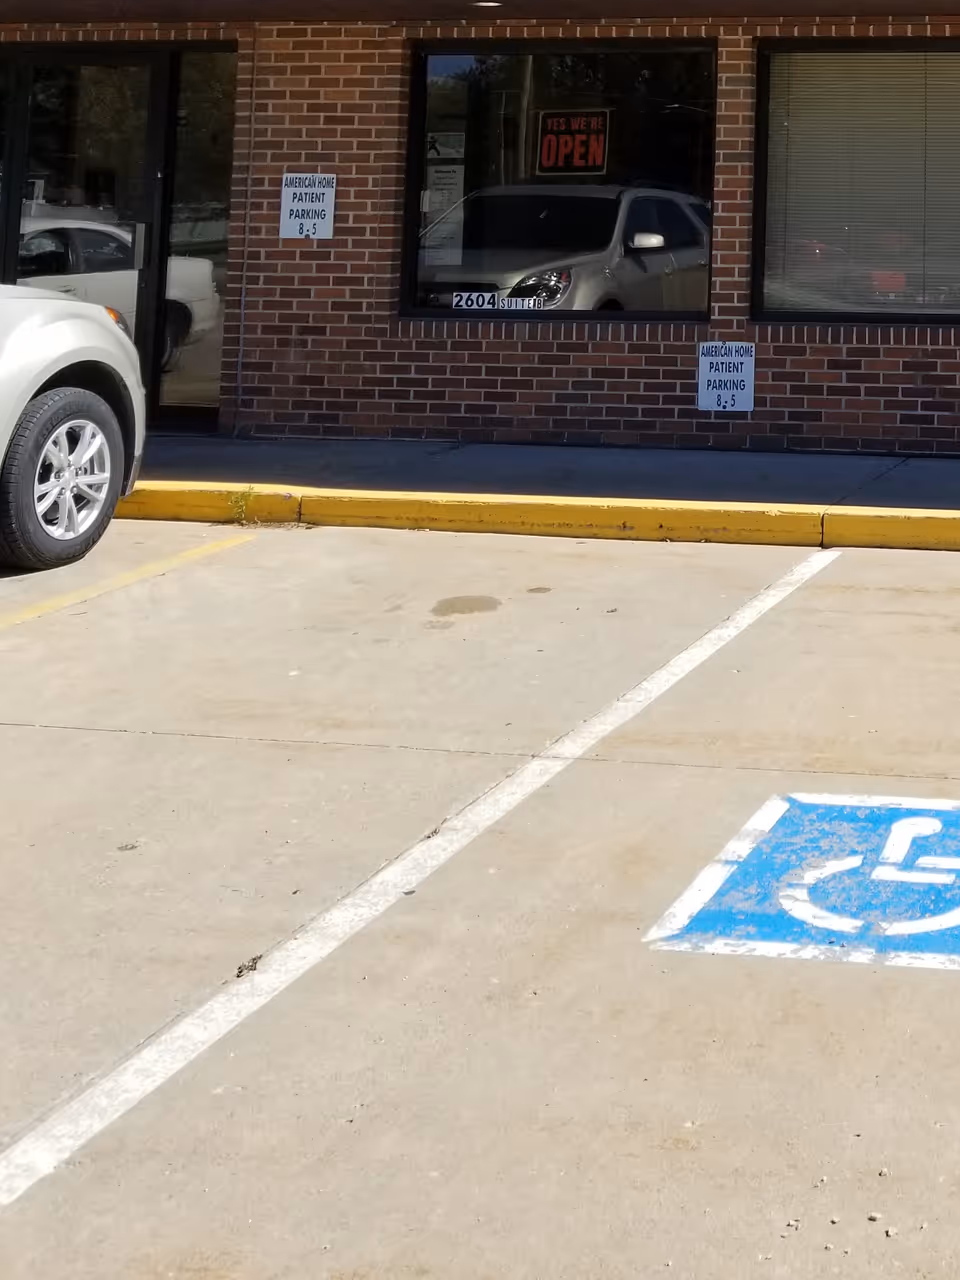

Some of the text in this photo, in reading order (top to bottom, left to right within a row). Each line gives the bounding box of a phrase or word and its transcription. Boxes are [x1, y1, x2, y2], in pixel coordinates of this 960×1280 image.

[546, 117, 566, 131] YES
[541, 133, 605, 168] OPEN
[284, 176, 335, 189] AMERICAN HOME
[292, 192, 326, 203] PATIENT
[288, 209, 327, 220] PARKING
[298, 222, 304, 235] 8
[312, 223, 317, 235] 5
[453, 293, 497, 308] 2604
[500, 298, 533, 309] SUITE
[701, 345, 754, 358] AMERICAN HOME
[709, 361, 744, 373] PATIENT
[706, 379, 746, 391] PARKING
[716, 394, 722, 407] 8
[730, 394, 736, 407] 5
